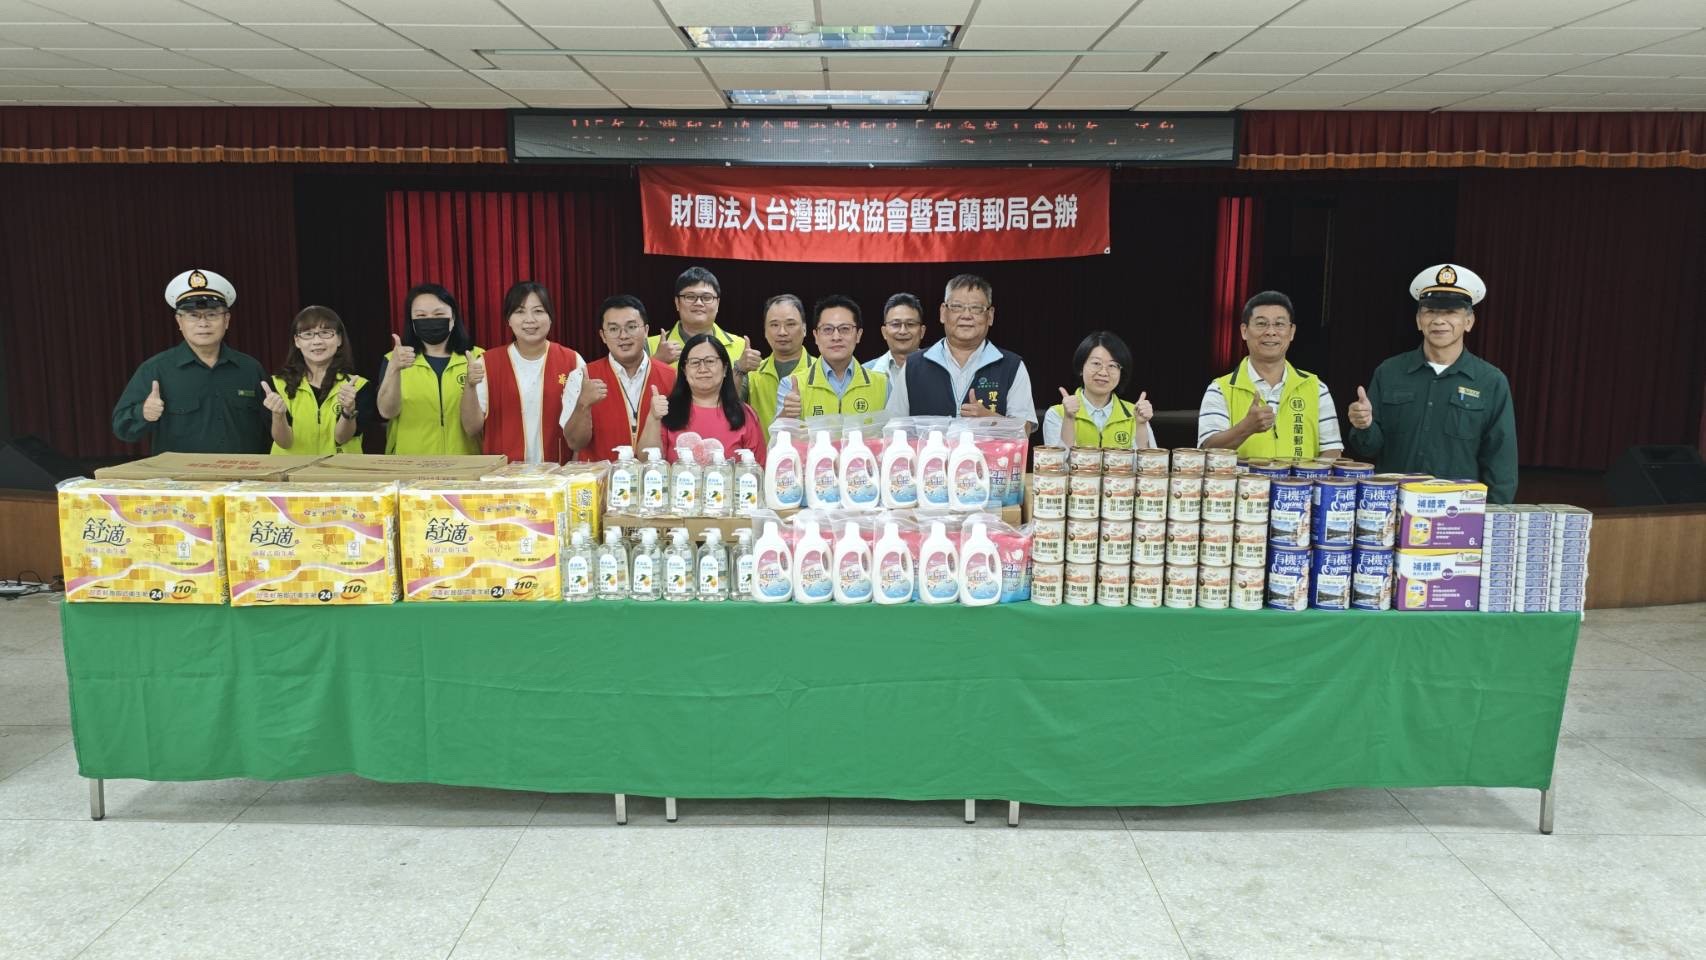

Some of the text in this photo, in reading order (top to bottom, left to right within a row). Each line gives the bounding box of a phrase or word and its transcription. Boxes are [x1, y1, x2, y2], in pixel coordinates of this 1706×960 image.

[670, 191, 1079, 234] 財團法人台灣郵政協會暨宜蘭郵局合辦
[1293, 413, 1304, 461] 宜蘭郵局
